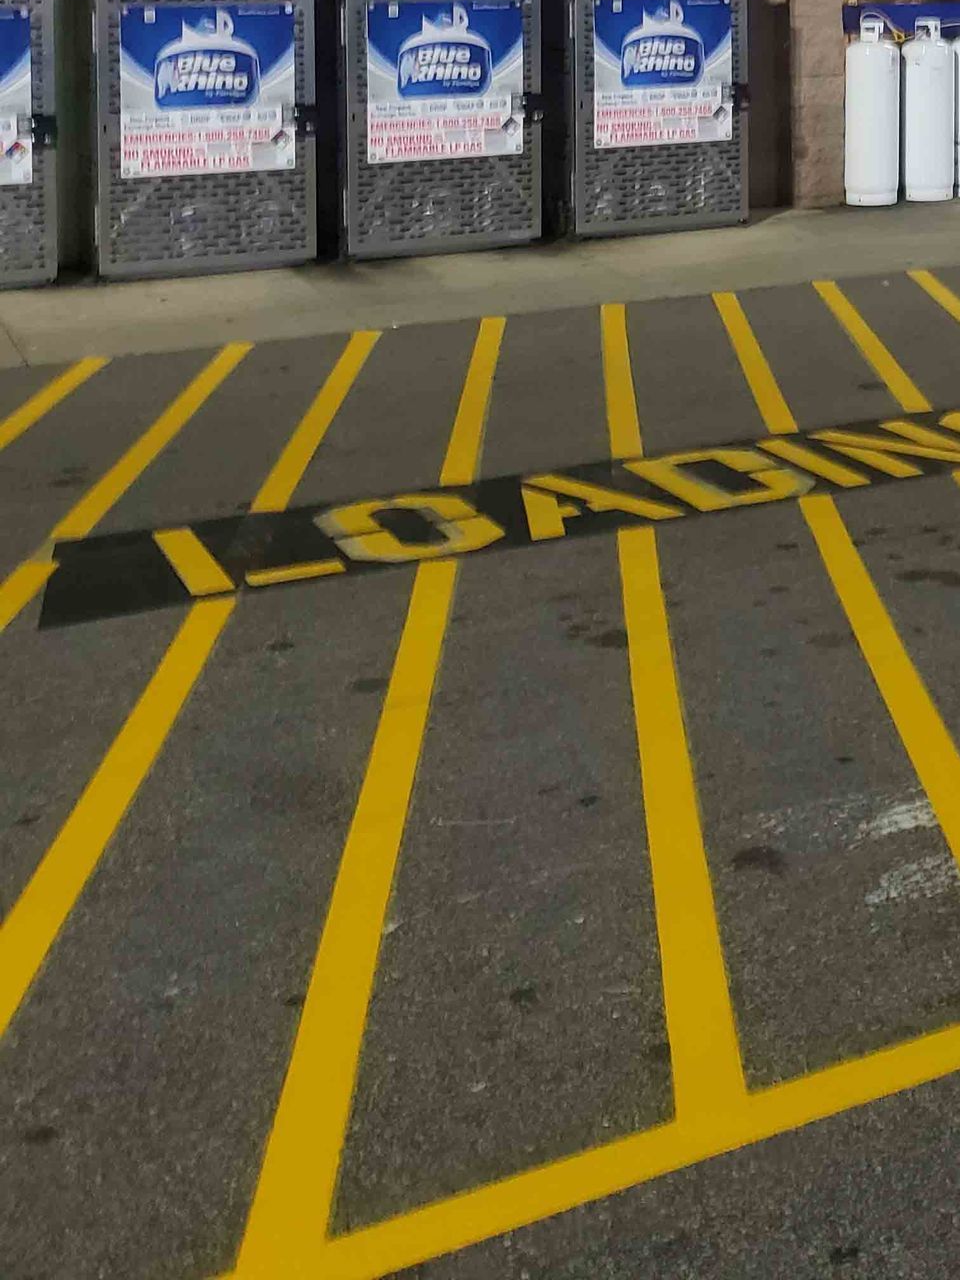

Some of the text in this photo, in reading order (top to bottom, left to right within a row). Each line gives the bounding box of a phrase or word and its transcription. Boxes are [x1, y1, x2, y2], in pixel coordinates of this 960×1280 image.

[418, 46, 471, 65] Blue
[640, 38, 686, 57] Blue
[178, 52, 236, 73] Blue
[639, 55, 696, 72] Rhino
[177, 71, 248, 91] Rhino
[418, 63, 481, 82] Rhino
